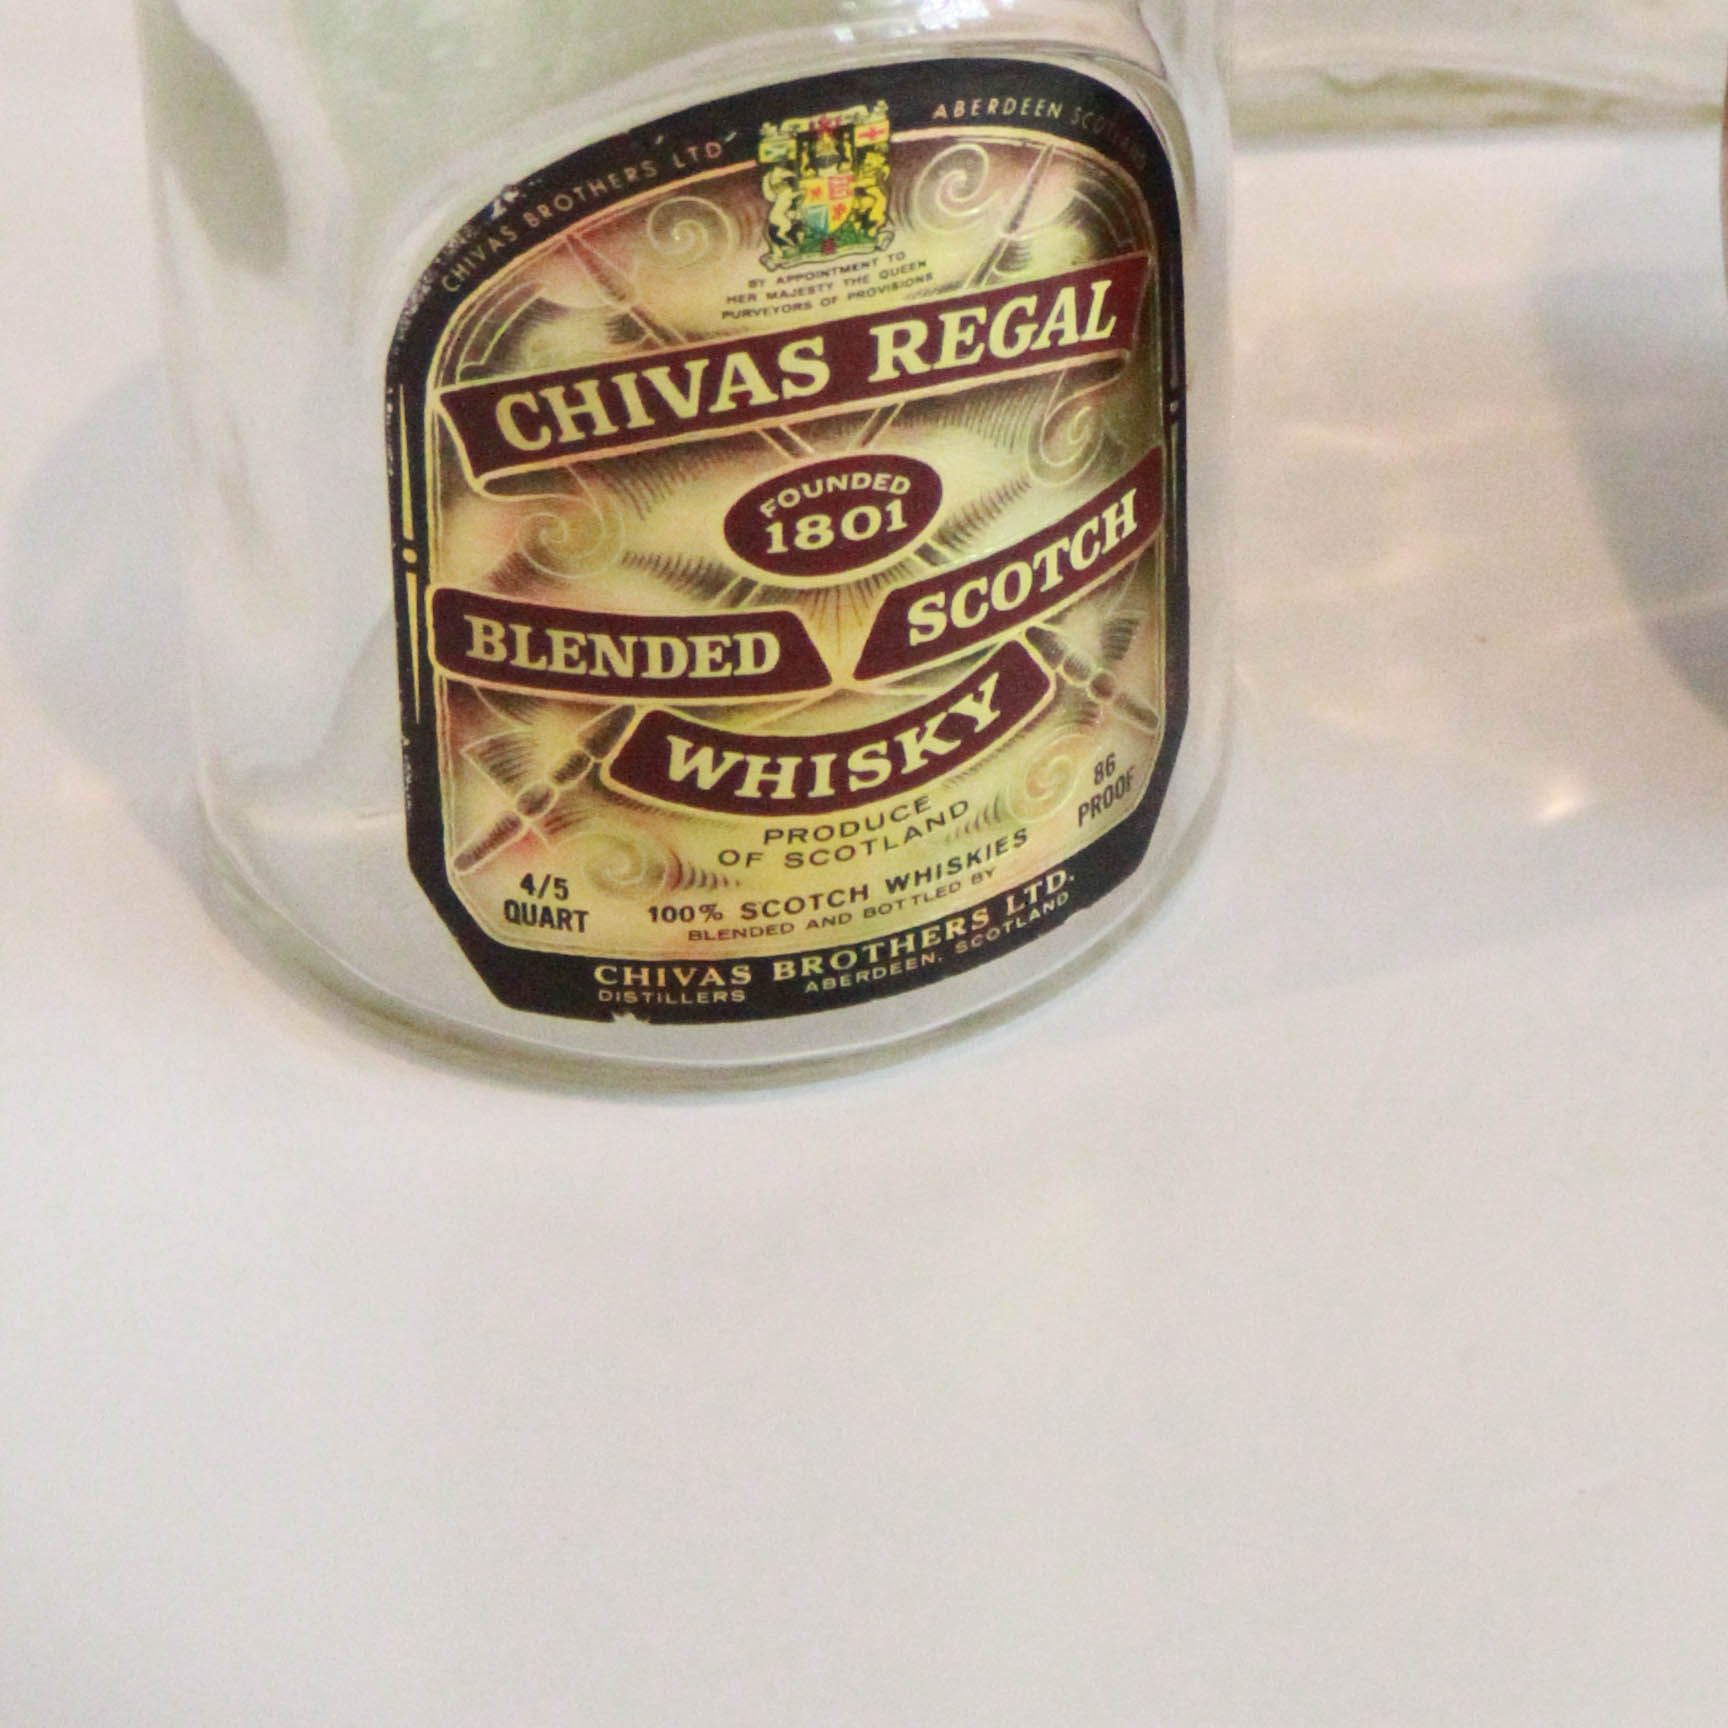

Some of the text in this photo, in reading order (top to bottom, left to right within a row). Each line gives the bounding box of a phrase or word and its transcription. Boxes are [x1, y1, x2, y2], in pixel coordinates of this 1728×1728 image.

[932, 97, 1063, 119] ABERDEEN
[441, 225, 518, 292] CHIVAS
[523, 159, 657, 229] BROTHERS
[721, 271, 934, 321] PURVEYORS OF PROVISIONS
[726, 259, 928, 305] HER MAJESTY THE QUEEN
[748, 250, 907, 289] BY APPOINTMENT TO
[495, 279, 1119, 453] CHIVAS REGAL
[761, 471, 912, 518] FOUNDED
[766, 500, 909, 556] 1801
[464, 488, 1140, 682] BLENDED SCOTCH
[665, 670, 1004, 801] WHISKY
[1093, 751, 1118, 788] 86
[763, 794, 932, 846] PRODUCE
[1076, 766, 1138, 830] PROOF
[718, 799, 970, 869] OF SCOTLAND
[518, 873, 570, 903] 4/5
[648, 827, 1028, 925] 100% SCOTCH WHISKIES
[503, 897, 590, 934] QUART
[593, 867, 1076, 989] CHIVAS BROTHERS LTD.
[687, 866, 997, 943] BLENDED AND BOTTLED BY
[955, 891, 1070, 956] SCOTLAND
[598, 988, 747, 1005] DISTILLERS
